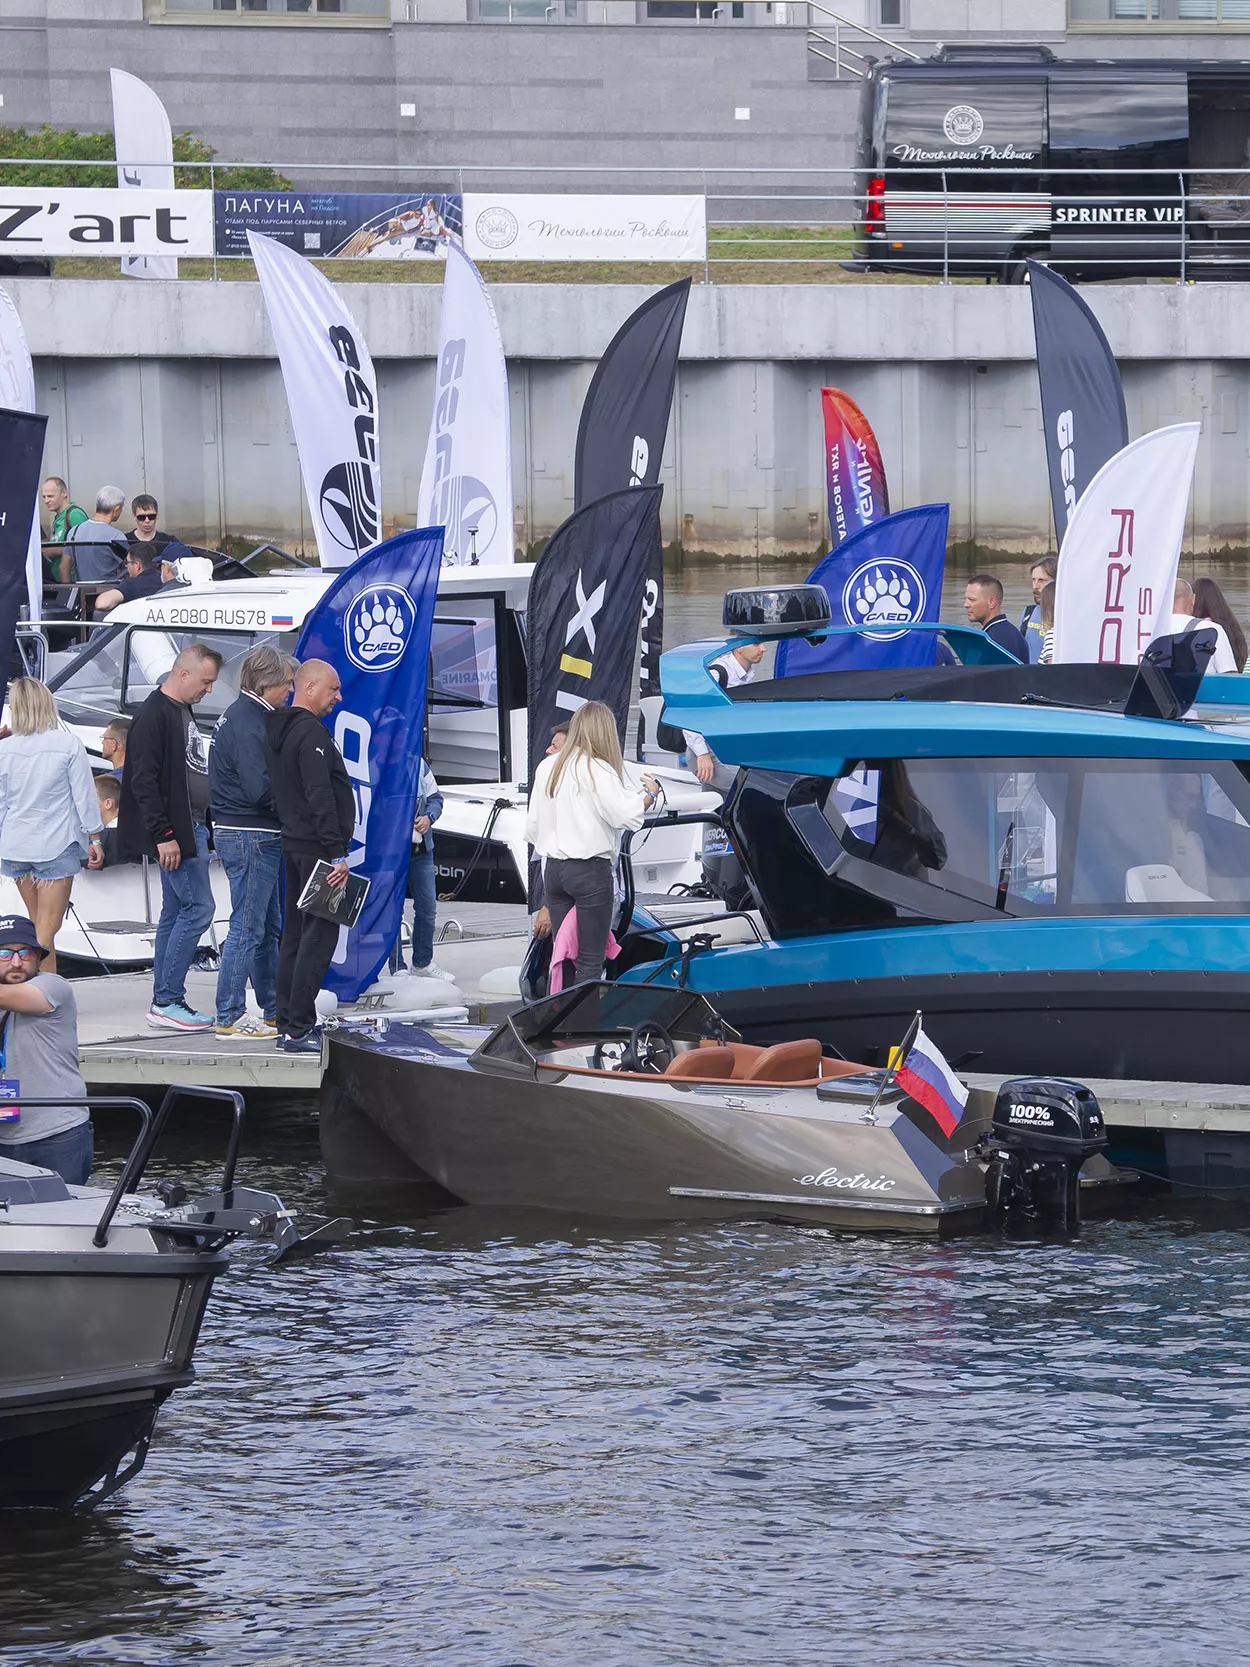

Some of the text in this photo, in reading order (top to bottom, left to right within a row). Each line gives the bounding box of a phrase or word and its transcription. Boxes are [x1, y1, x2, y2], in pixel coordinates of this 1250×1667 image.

[225, 198, 305, 213] ЛАГУНА
[1056, 207, 1184, 222] SPRINTER VIP
[527, 220, 627, 238] Технологии
[628, 220, 690, 238] Роскоши
[1099, 508, 1135, 664] ORY
[146, 609, 266, 625] AA 2080 RUS78
[866, 612, 909, 622] CAED
[363, 641, 402, 654] CAED
[1009, 1104, 1051, 1120] 100%
[792, 1167, 896, 1191] electric
